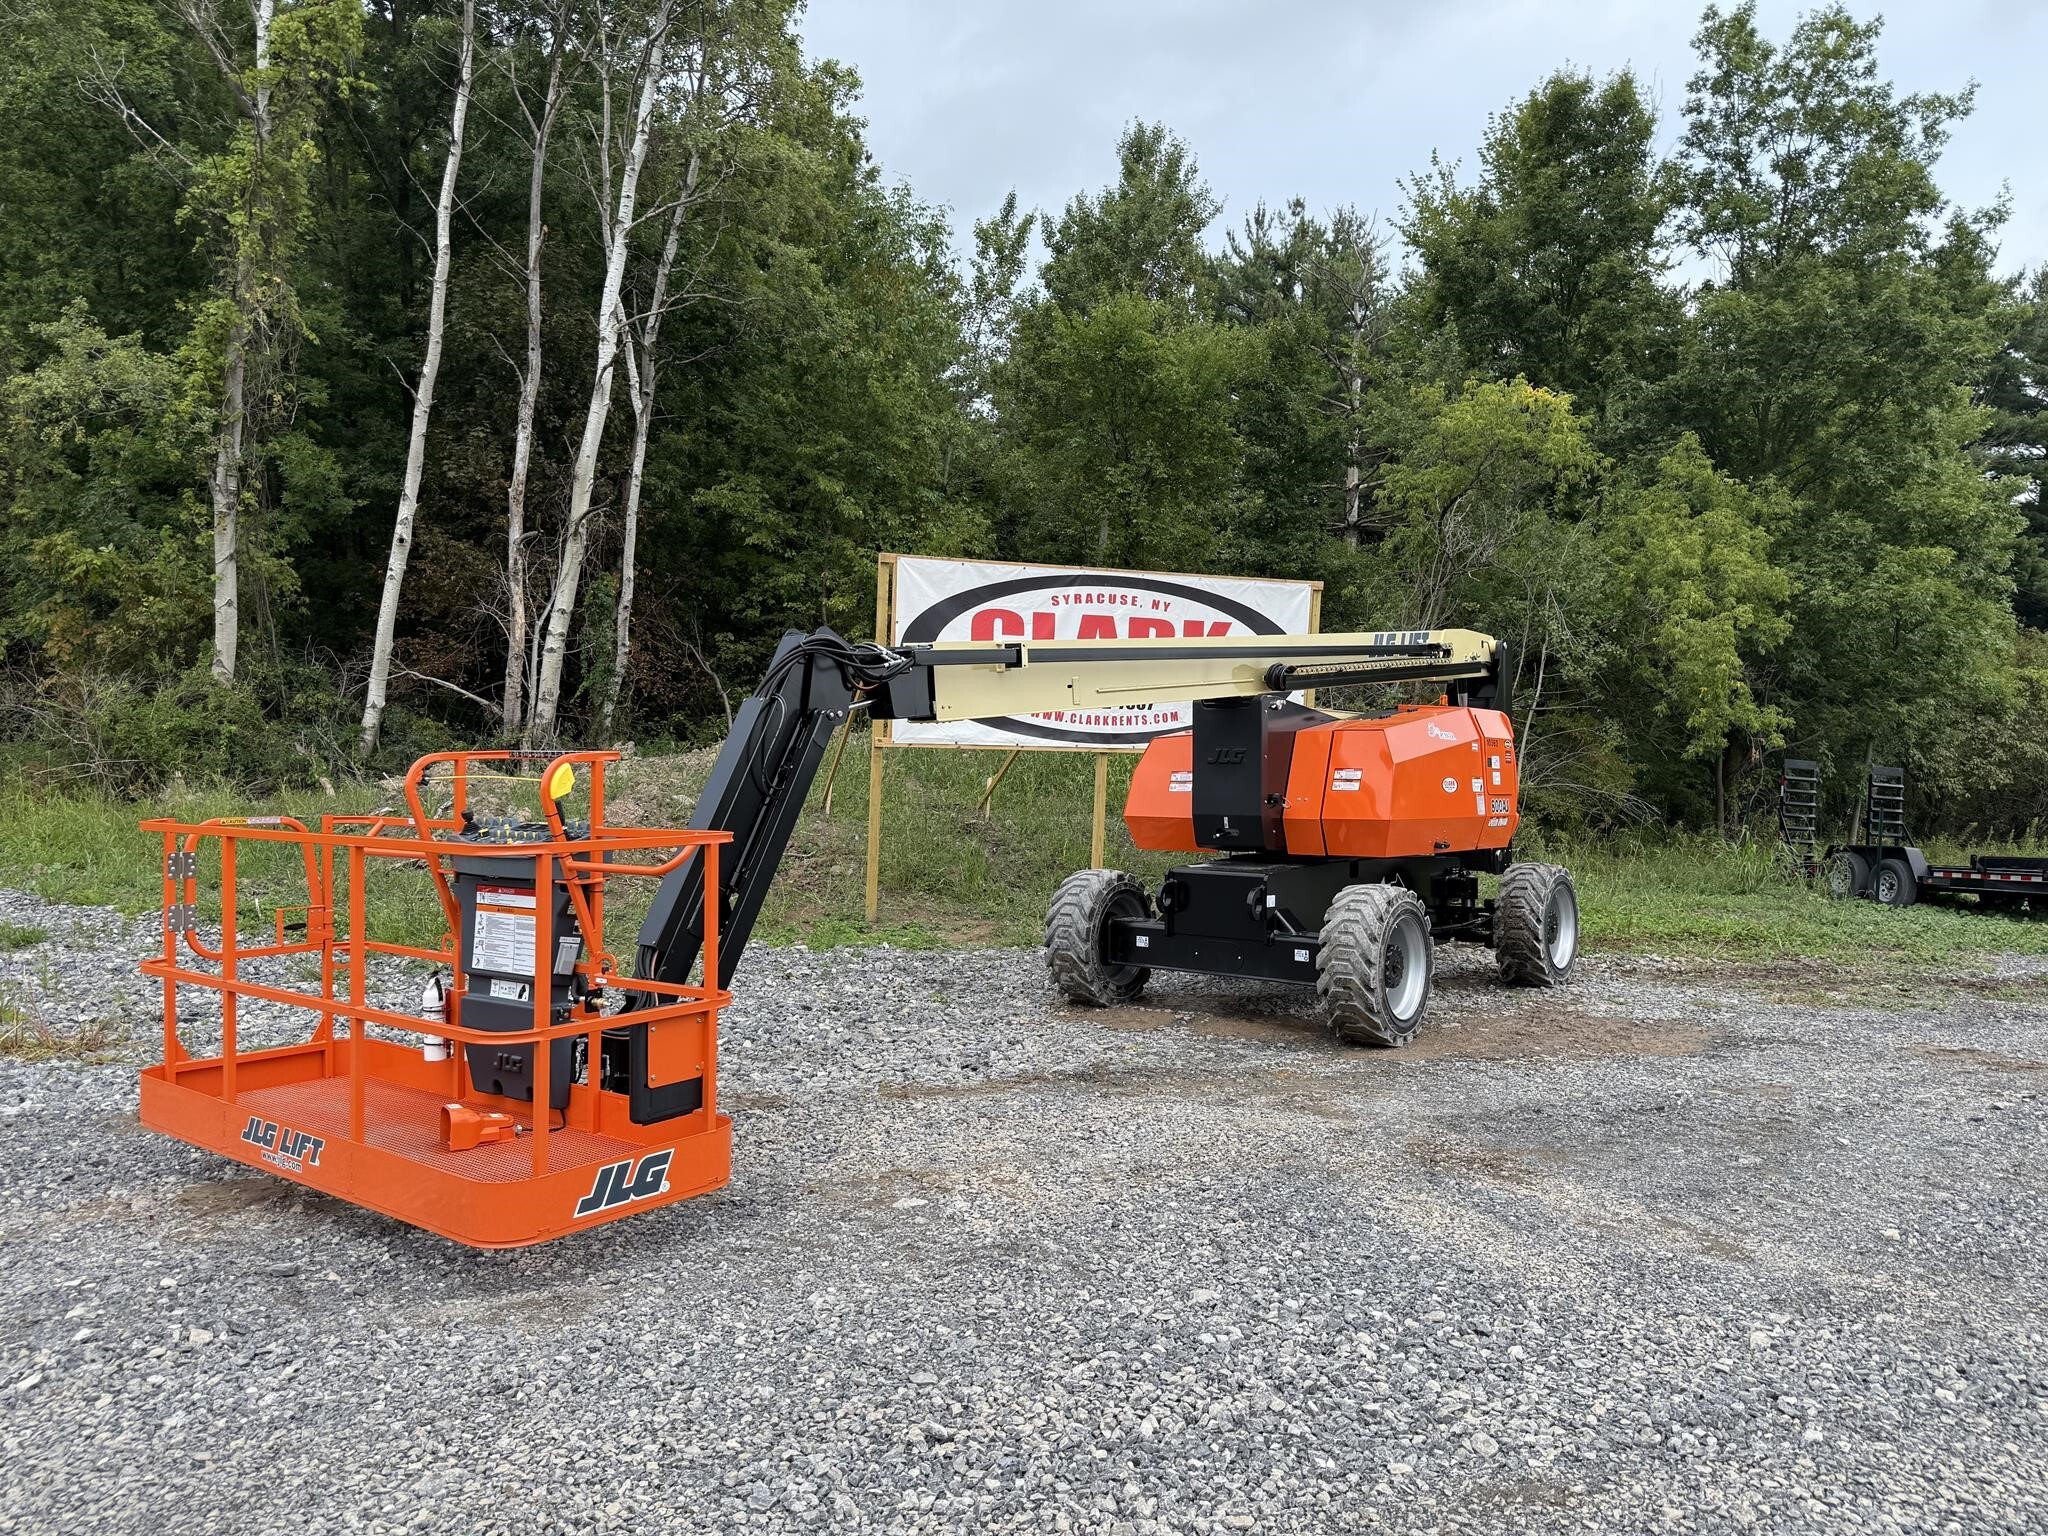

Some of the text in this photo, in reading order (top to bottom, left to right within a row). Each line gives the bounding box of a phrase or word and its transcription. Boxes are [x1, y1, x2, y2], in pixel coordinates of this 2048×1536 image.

[1051, 593, 1171, 612] SYRACUSE, NY
[1208, 747, 1248, 765] JLG
[241, 1116, 325, 1164] JLG LIFT
[573, 1148, 675, 1218] JLG
